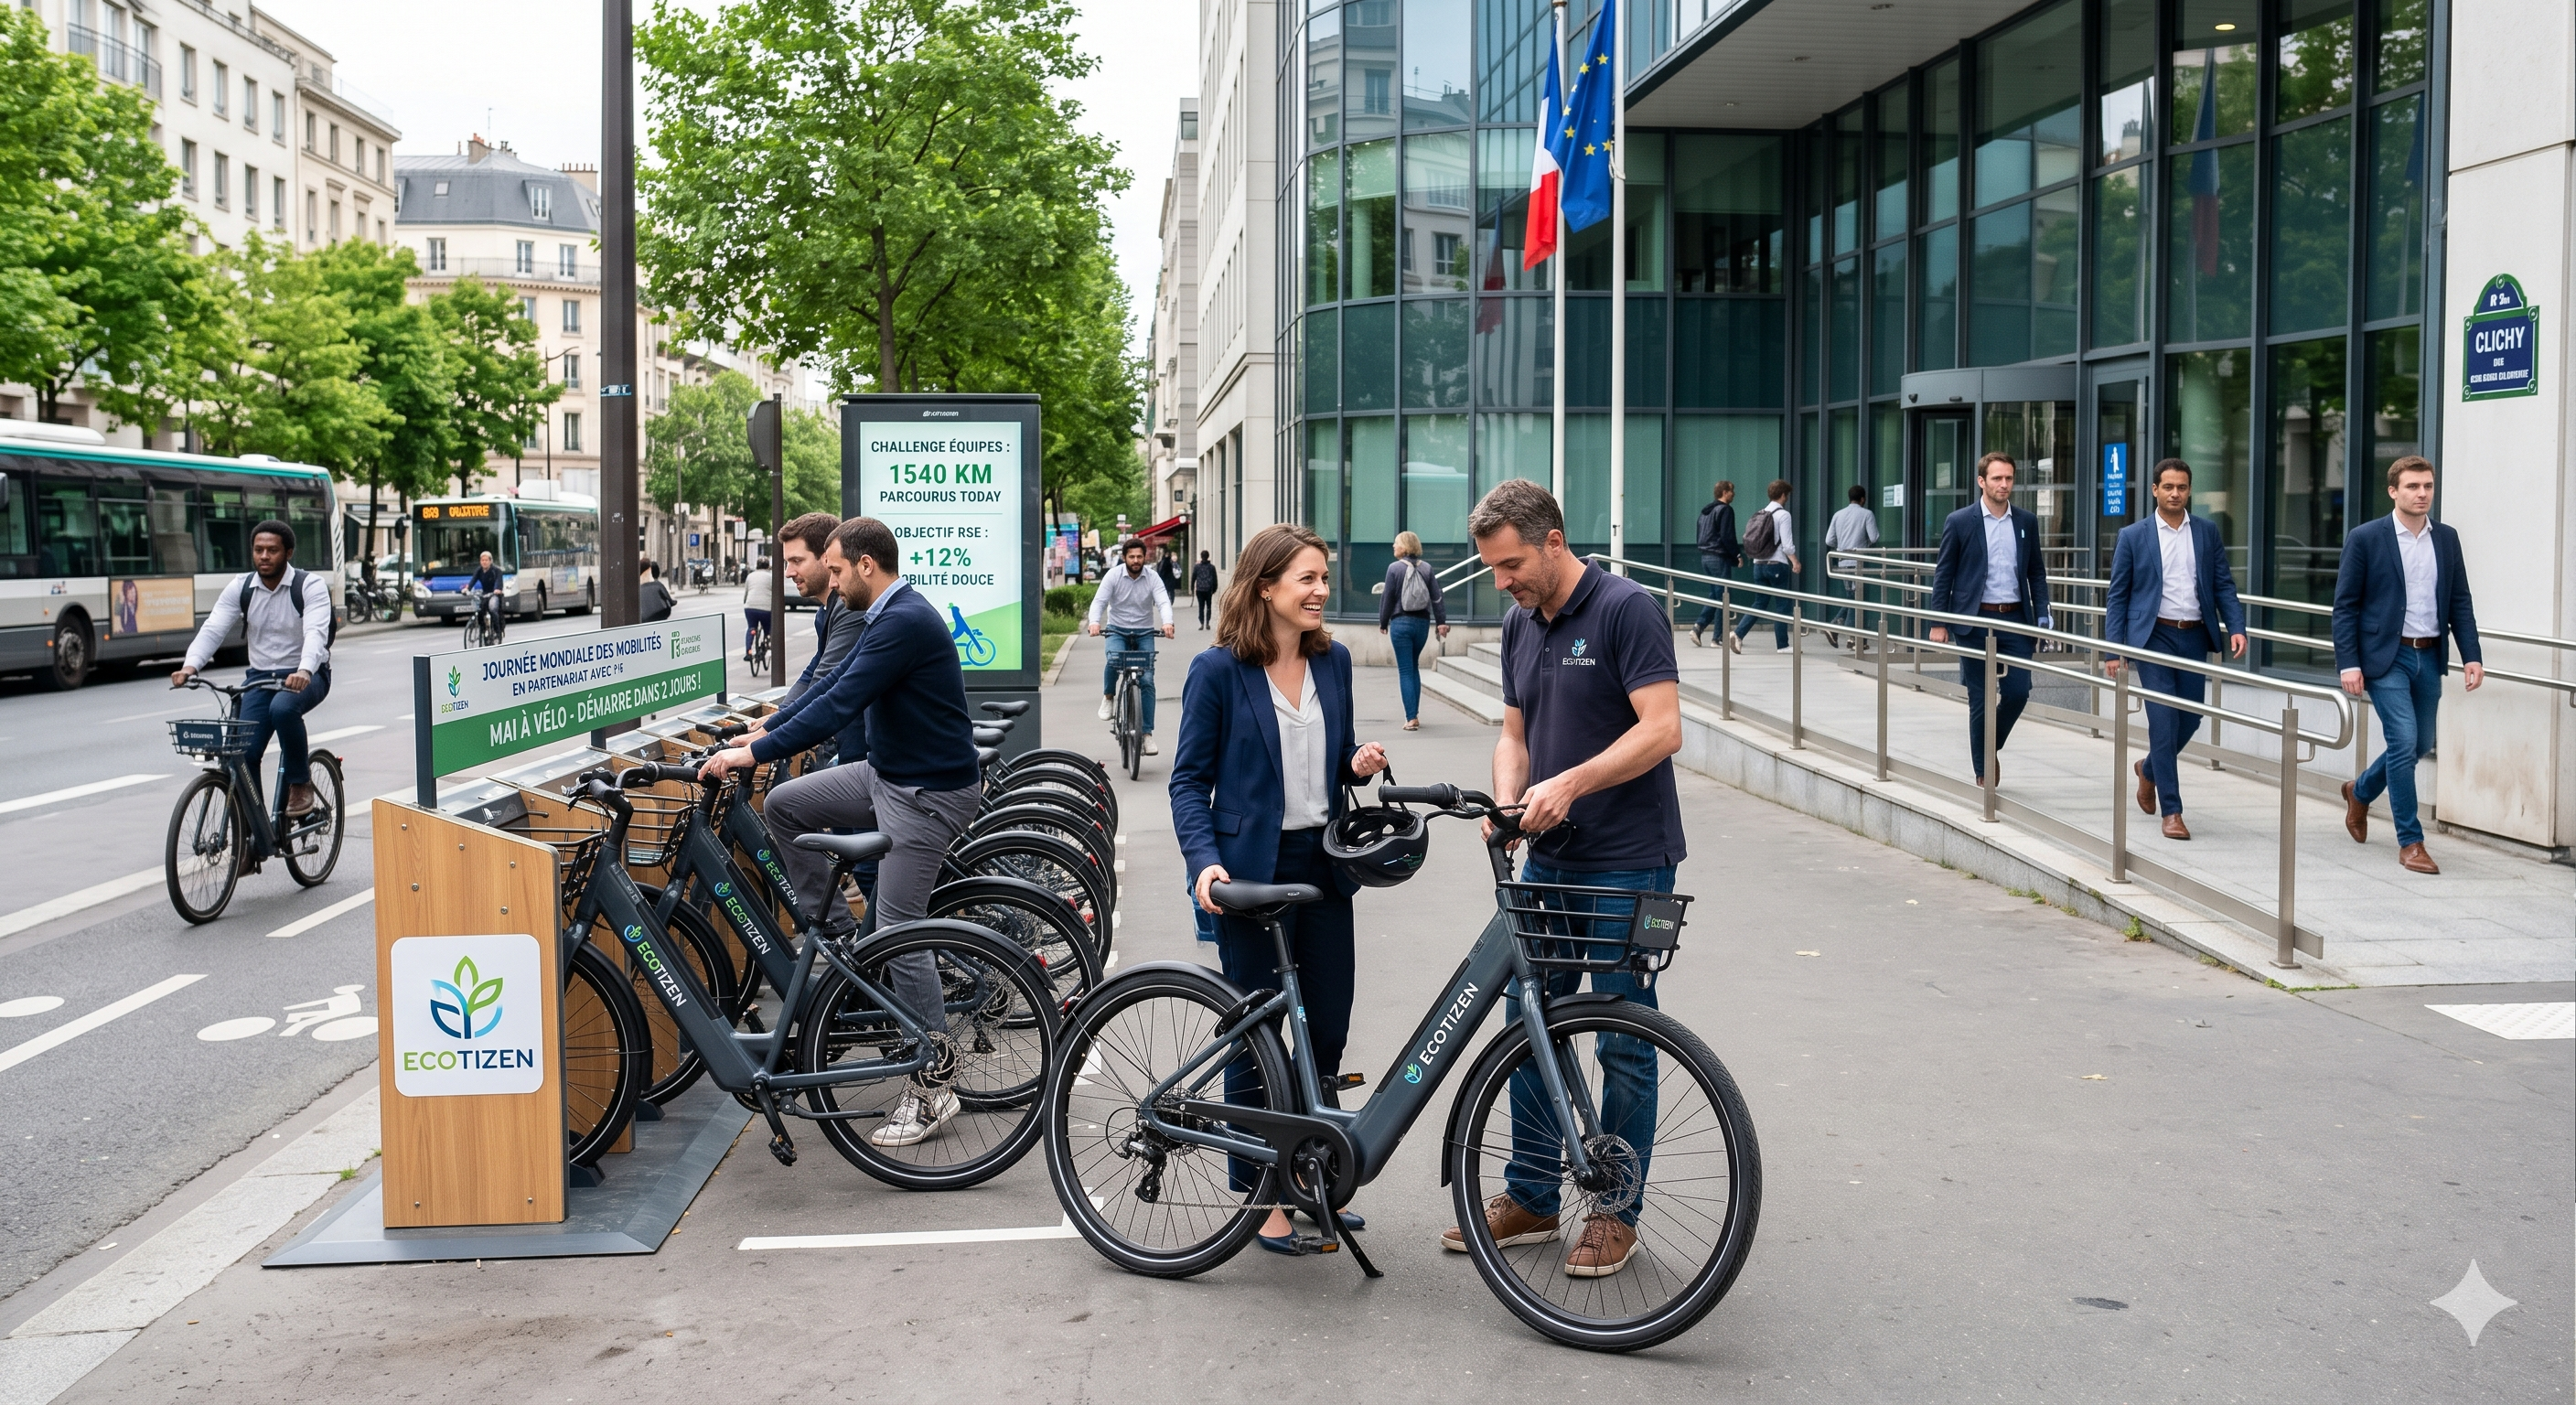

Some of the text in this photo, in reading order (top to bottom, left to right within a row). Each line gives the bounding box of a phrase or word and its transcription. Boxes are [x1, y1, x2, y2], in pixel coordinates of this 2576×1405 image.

[2475, 326, 2526, 354] CLICHY
[871, 438, 1011, 454] CHALLENGE ÉQUIPES :
[889, 463, 992, 485] 1540 KM
[880, 490, 1002, 503] PARCOURUS TODAY
[895, 527, 988, 538] OBJECTIF RSE :
[909, 548, 971, 567] +12%
[902, 572, 994, 585] BILITÉ DOUCE
[483, 650, 537, 681] JOURNÉE
[540, 646, 594, 670] MONDIALE
[596, 643, 614, 660] DES
[616, 631, 662, 657] MOBILITÉS
[512, 681, 526, 696] EN
[528, 670, 588, 693] PARTENARIAT
[590, 665, 612, 681] AVEC
[489, 718, 517, 747] MAI
[521, 709, 531, 739] À
[533, 702, 567, 735] VÉLO
[577, 692, 632, 724] DÉMARRE
[634, 682, 660, 707] DANS
[661, 681, 668, 700] 2
[669, 673, 697, 698] JOURS
[698, 670, 701, 690] !
[724, 896, 771, 955] ECOTIZEN
[636, 941, 687, 1007] ECOTIZEN
[1419, 981, 1479, 1066] ECOTIZEN
[403, 1048, 533, 1071] ECOTIZEN
